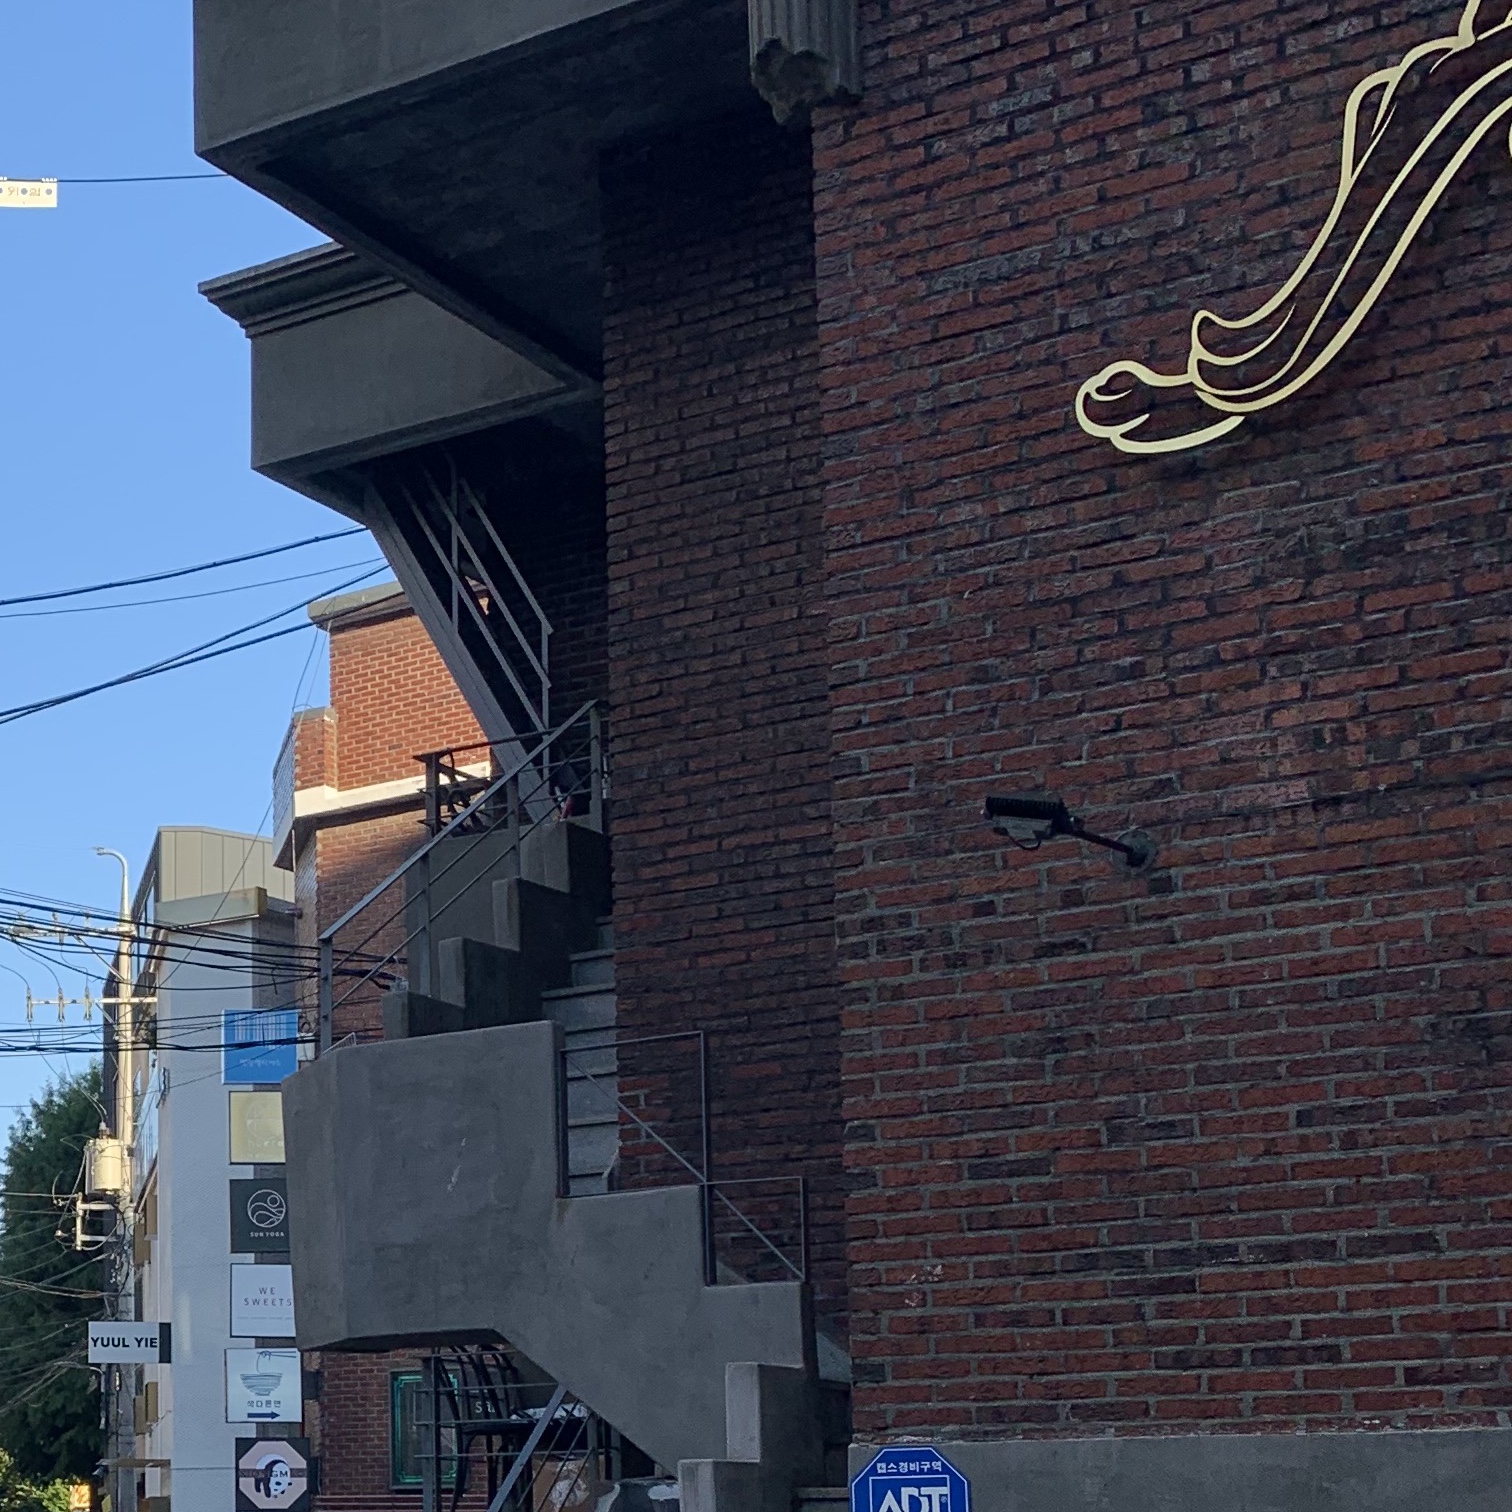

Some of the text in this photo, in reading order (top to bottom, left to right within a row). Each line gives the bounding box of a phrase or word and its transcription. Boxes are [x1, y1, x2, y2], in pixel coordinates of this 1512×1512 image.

[258, 1286, 276, 1295] WE
[243, 1297, 292, 1307] SWEETS
[90, 1336, 158, 1348] YUUL YIE
[876, 1461, 942, 1474] 캡스경비구역
